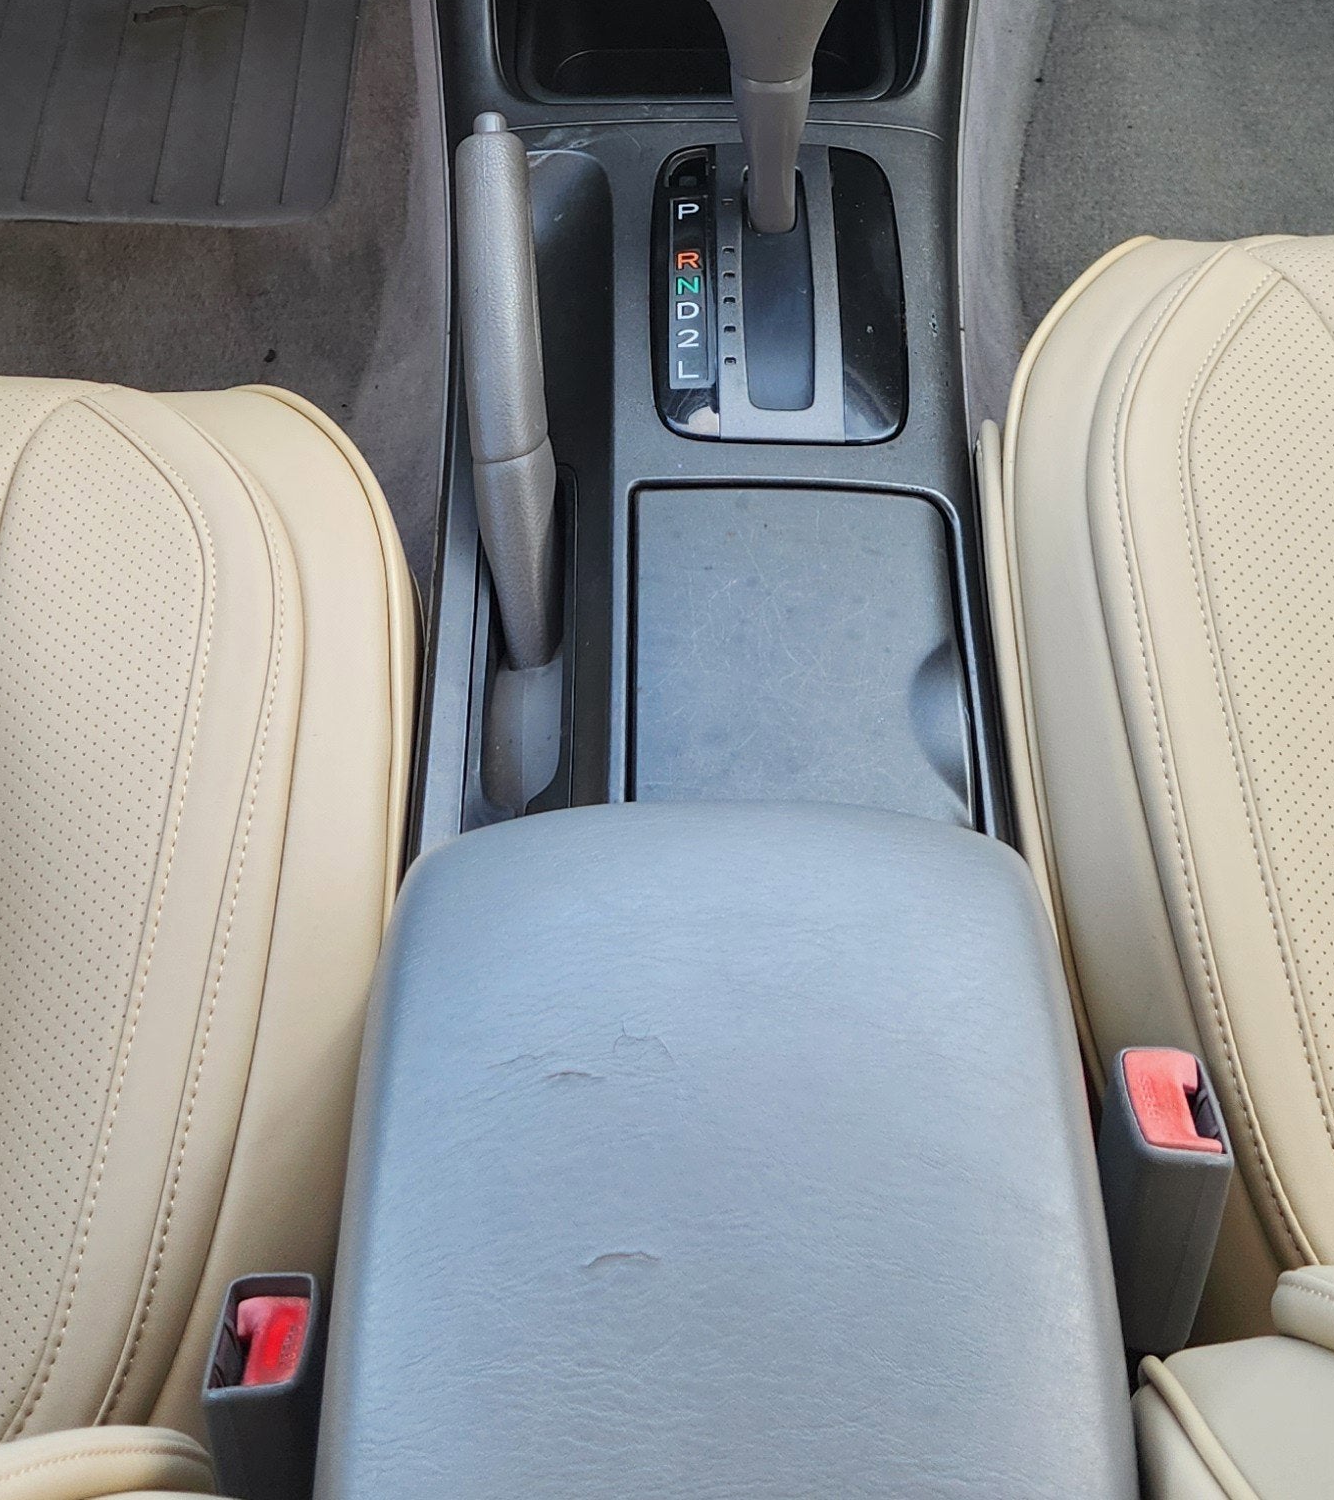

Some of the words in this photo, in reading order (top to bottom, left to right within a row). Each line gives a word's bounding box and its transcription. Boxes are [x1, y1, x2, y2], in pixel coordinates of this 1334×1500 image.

[677, 203, 700, 220] P
[677, 252, 701, 270] R
[677, 276, 700, 295] N
[677, 301, 700, 320] D
[677, 329, 699, 348] 2
[678, 360, 699, 379] L
